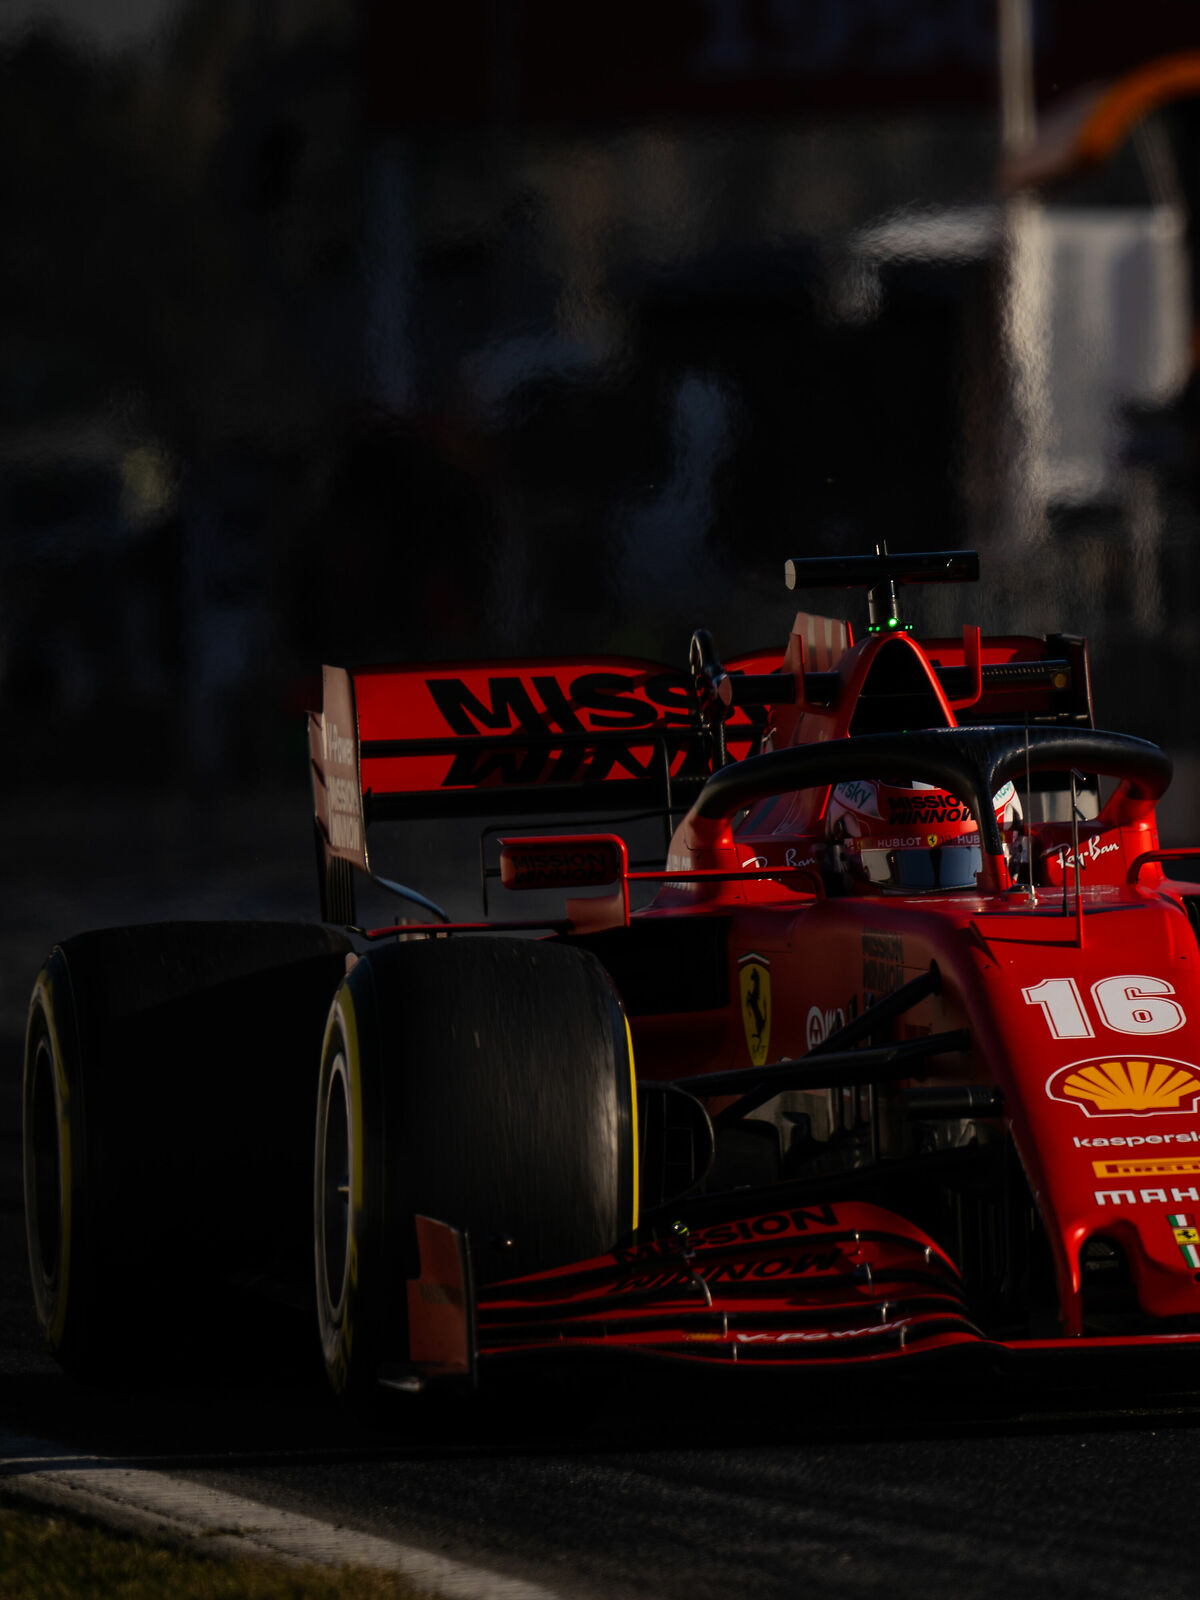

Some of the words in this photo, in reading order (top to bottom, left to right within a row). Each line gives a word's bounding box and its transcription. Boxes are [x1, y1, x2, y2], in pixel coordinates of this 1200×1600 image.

[877, 837, 922, 849] HUBLOT
[957, 834, 981, 845] HUB
[1040, 833, 1120, 869] Ray-Ban
[1020, 974, 1187, 1040] 16
